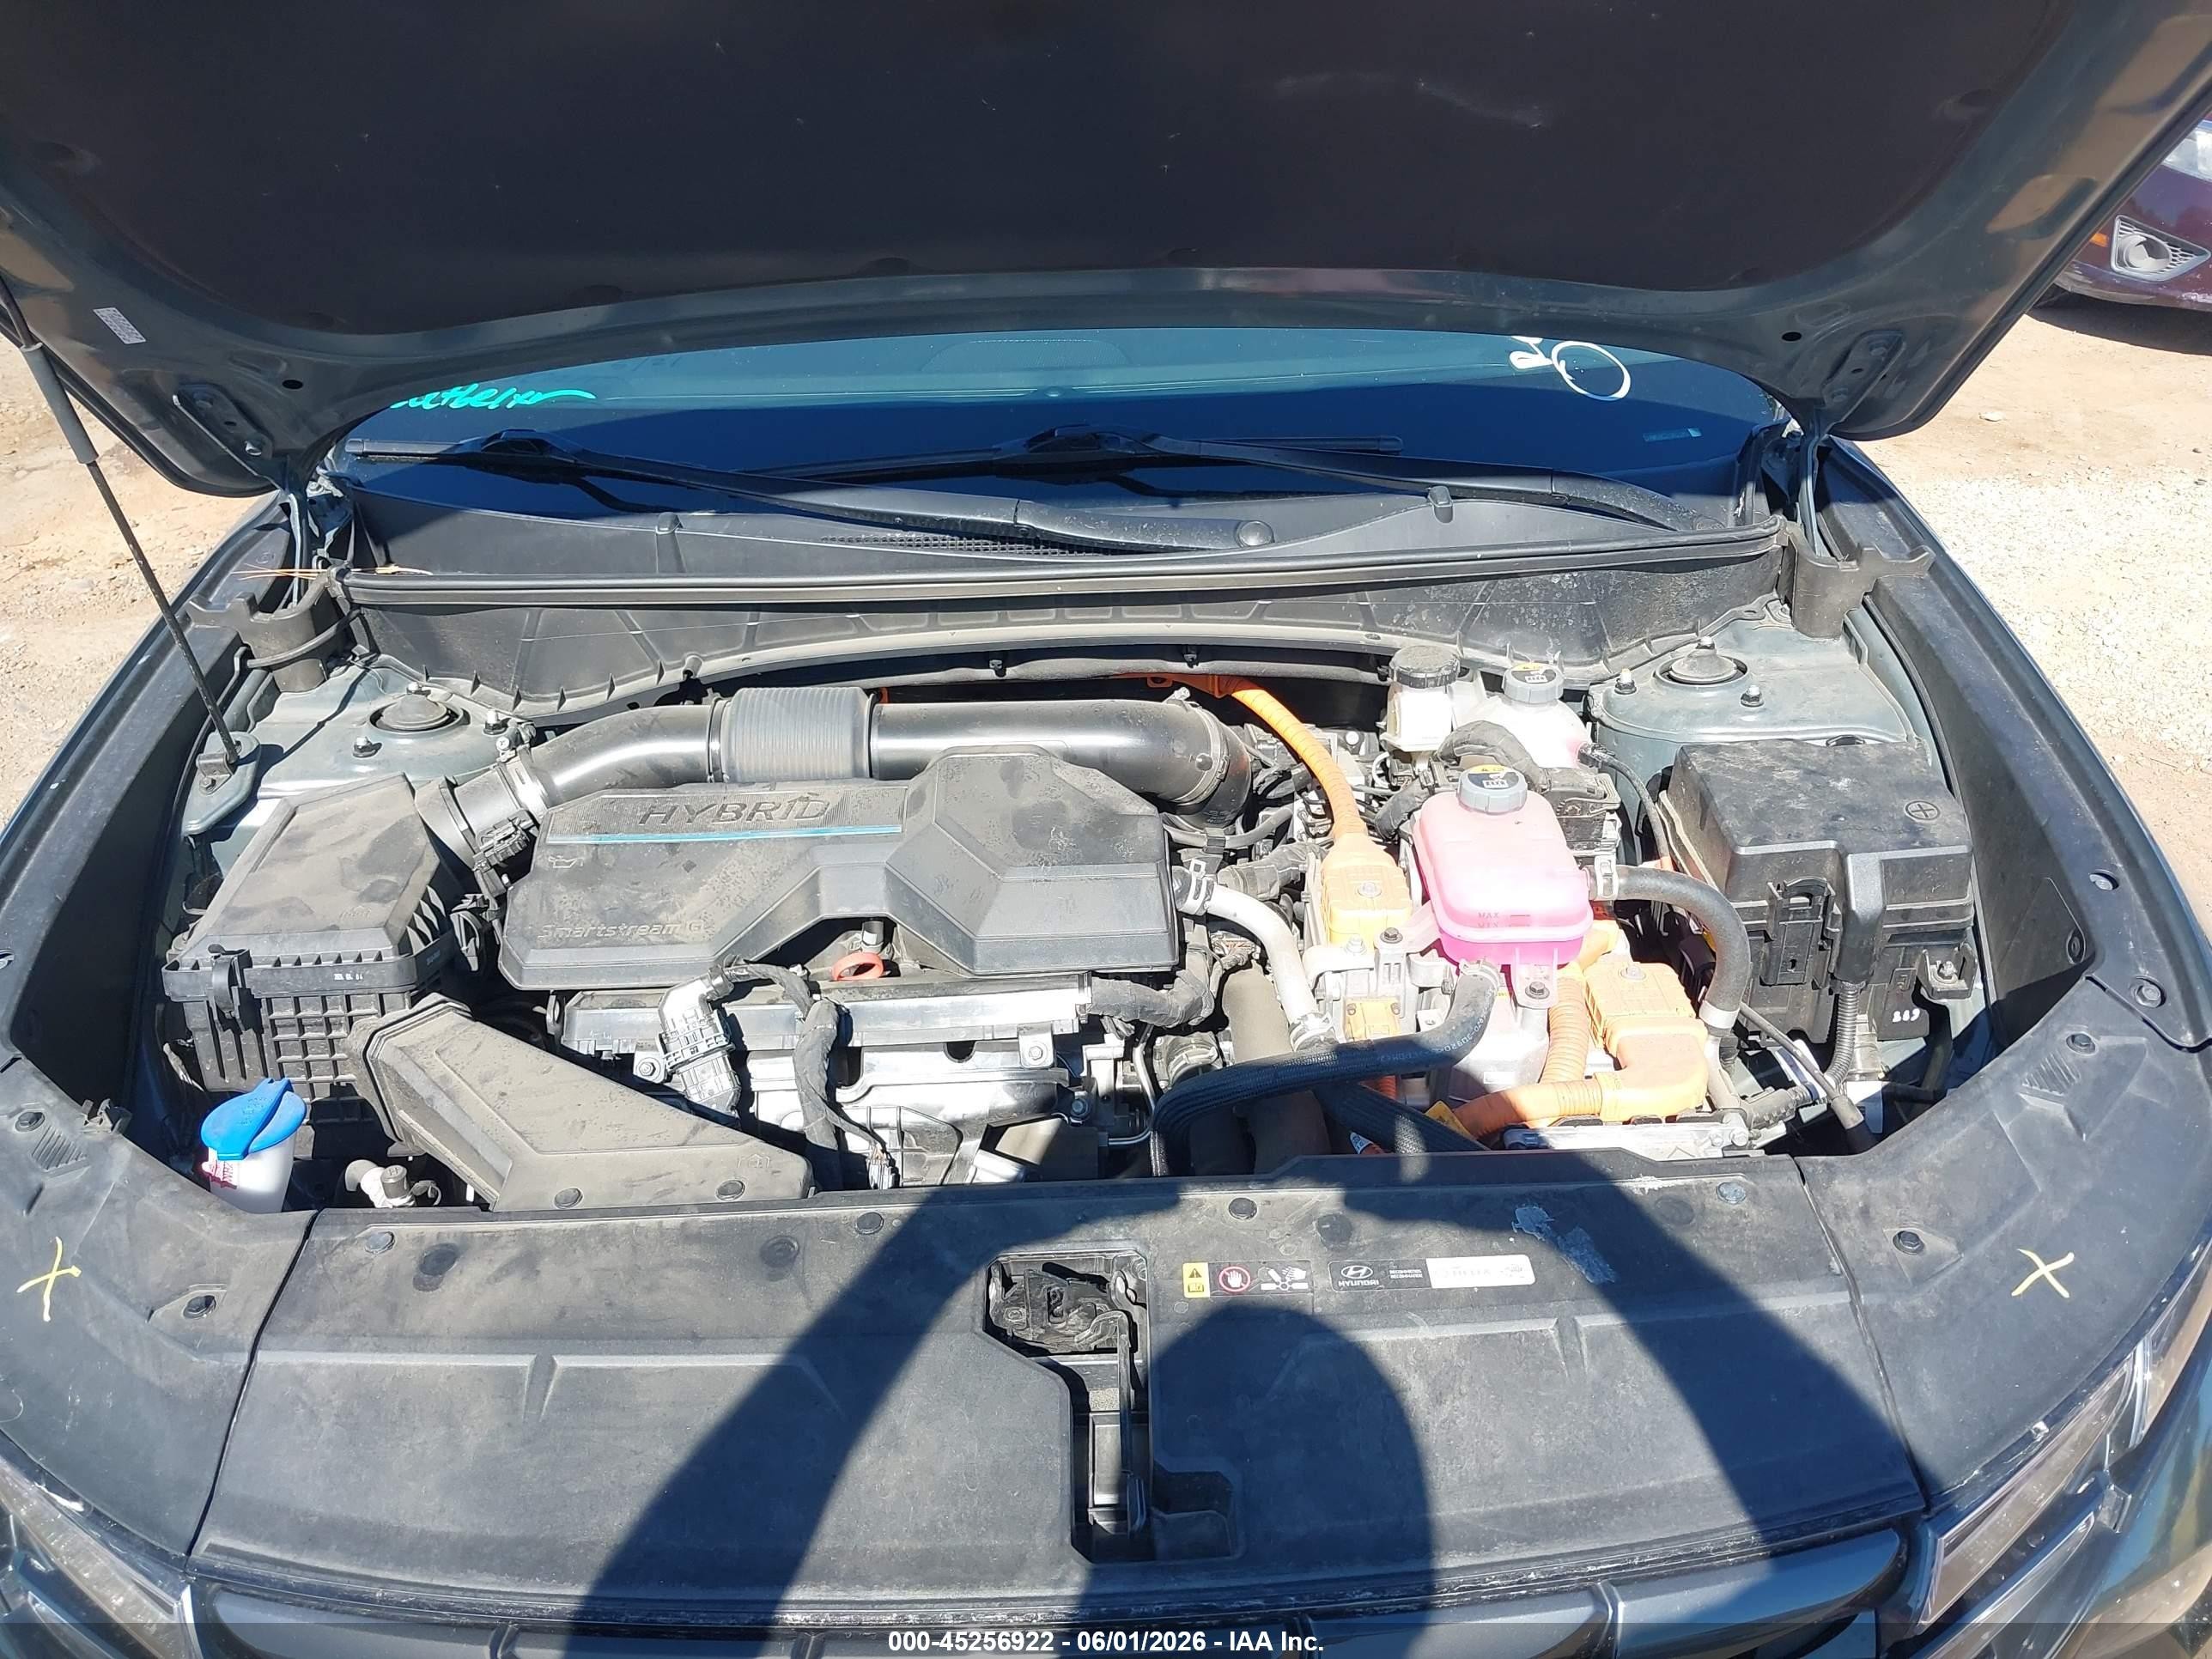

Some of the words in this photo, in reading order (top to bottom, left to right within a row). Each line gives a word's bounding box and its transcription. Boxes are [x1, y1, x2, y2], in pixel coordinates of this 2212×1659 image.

[638, 799, 831, 825] HYBRID
[538, 922, 681, 939] Smartstream
[686, 919, 704, 934] G
[1338, 1279, 1380, 1287] HYUNDAI
